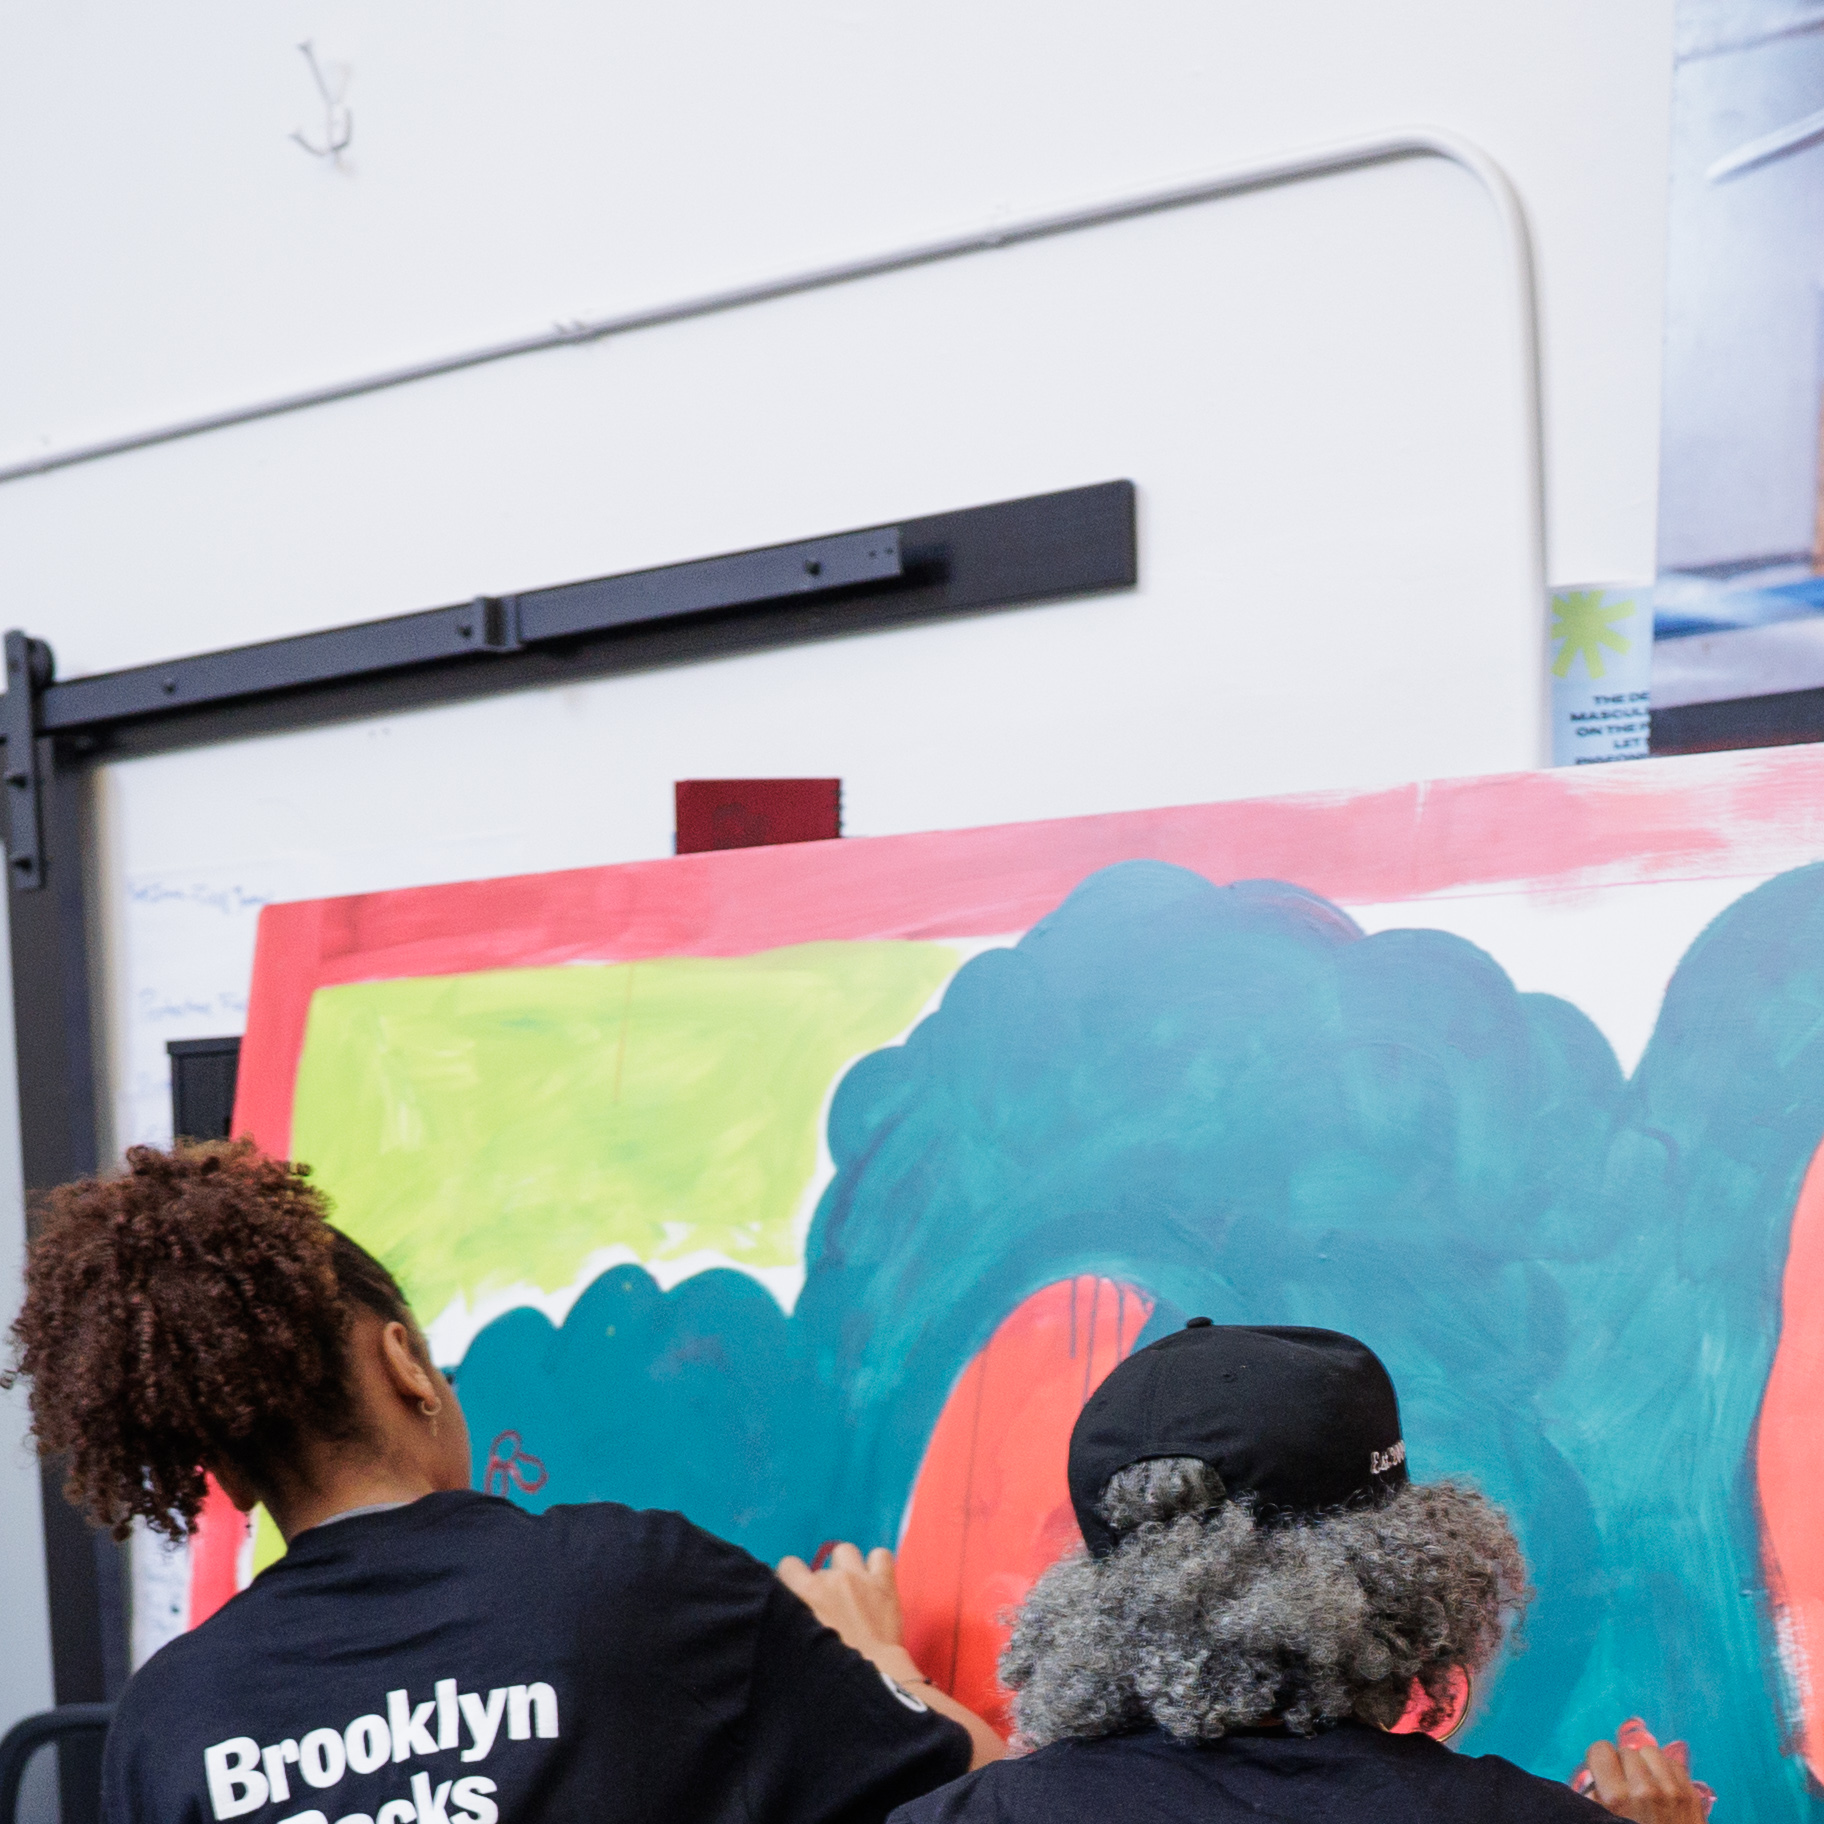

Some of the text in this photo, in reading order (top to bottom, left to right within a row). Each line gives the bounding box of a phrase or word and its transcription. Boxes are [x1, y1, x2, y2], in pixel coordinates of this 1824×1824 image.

[1594, 692, 1648, 704] THE DE
[1577, 727, 1601, 736] ON
[1607, 724, 1634, 733] THE
[204, 1678, 559, 1820] Brooklyn
